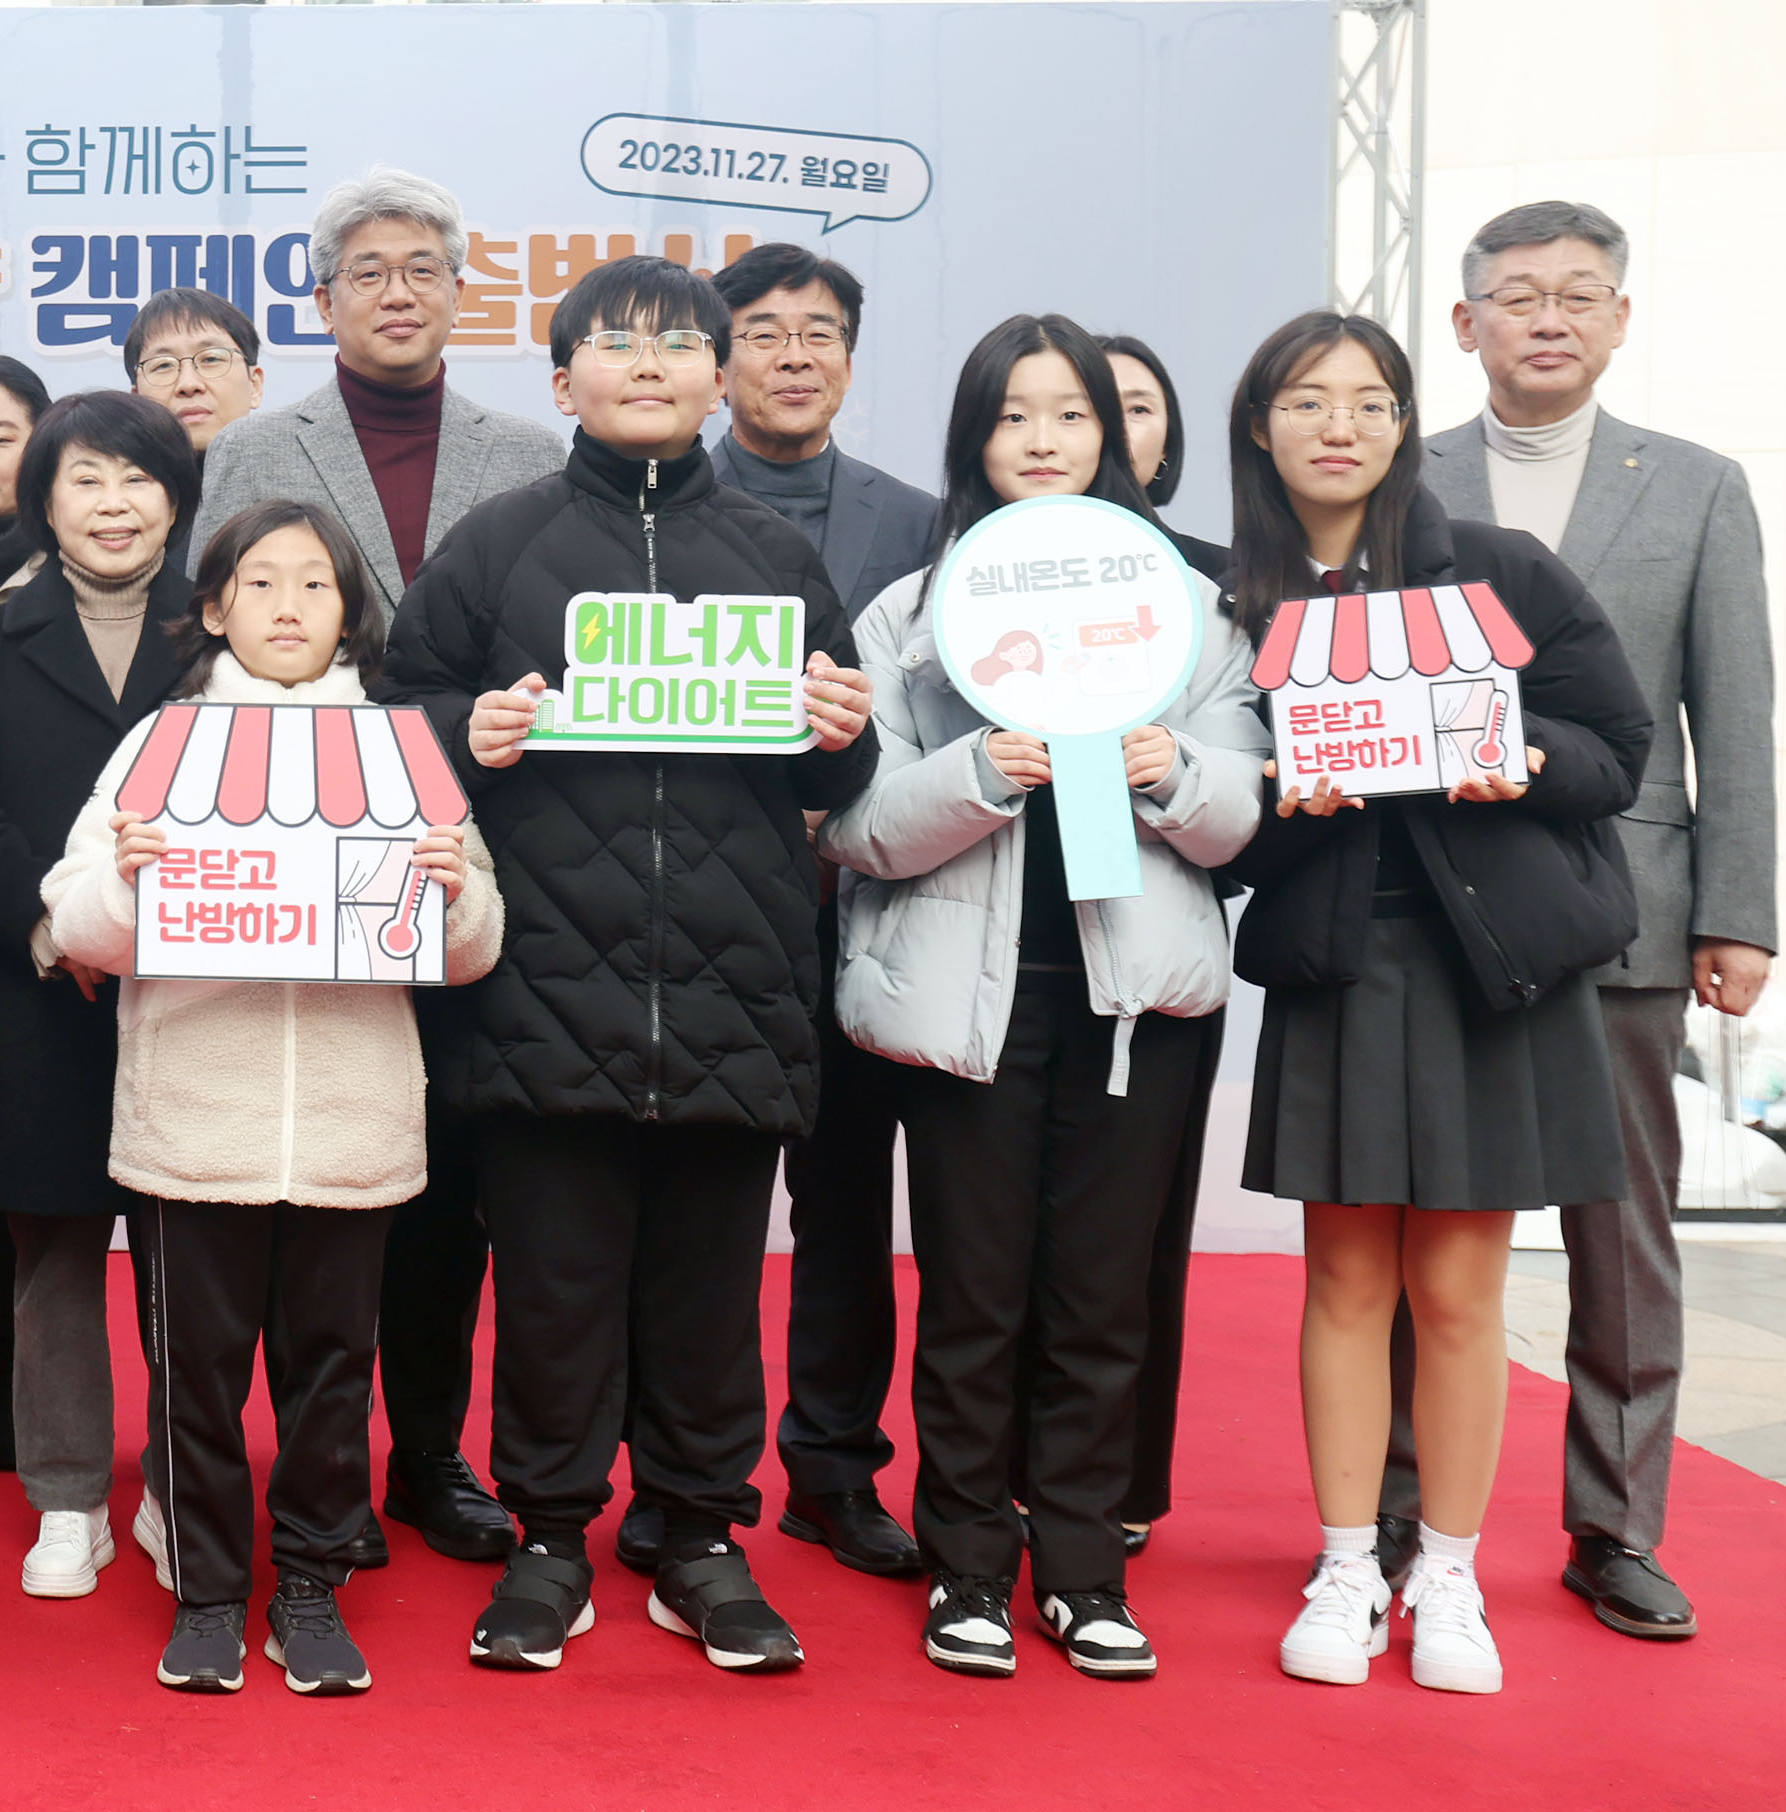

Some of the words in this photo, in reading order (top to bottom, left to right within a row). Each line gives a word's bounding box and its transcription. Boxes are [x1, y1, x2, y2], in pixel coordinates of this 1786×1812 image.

[25, 123, 308, 195] 함께하는
[618, 138, 789, 184] 2023.11.27.
[800, 155, 890, 194] 월요일
[965, 557, 1093, 597] 실내온도
[574, 601, 795, 669] 에너지
[572, 675, 795, 728] 다이어트
[1289, 698, 1386, 736] 문닫고
[1292, 734, 1422, 775] 난방하기
[158, 848, 278, 890] 문닫고
[158, 900, 317, 945] 난방하기
